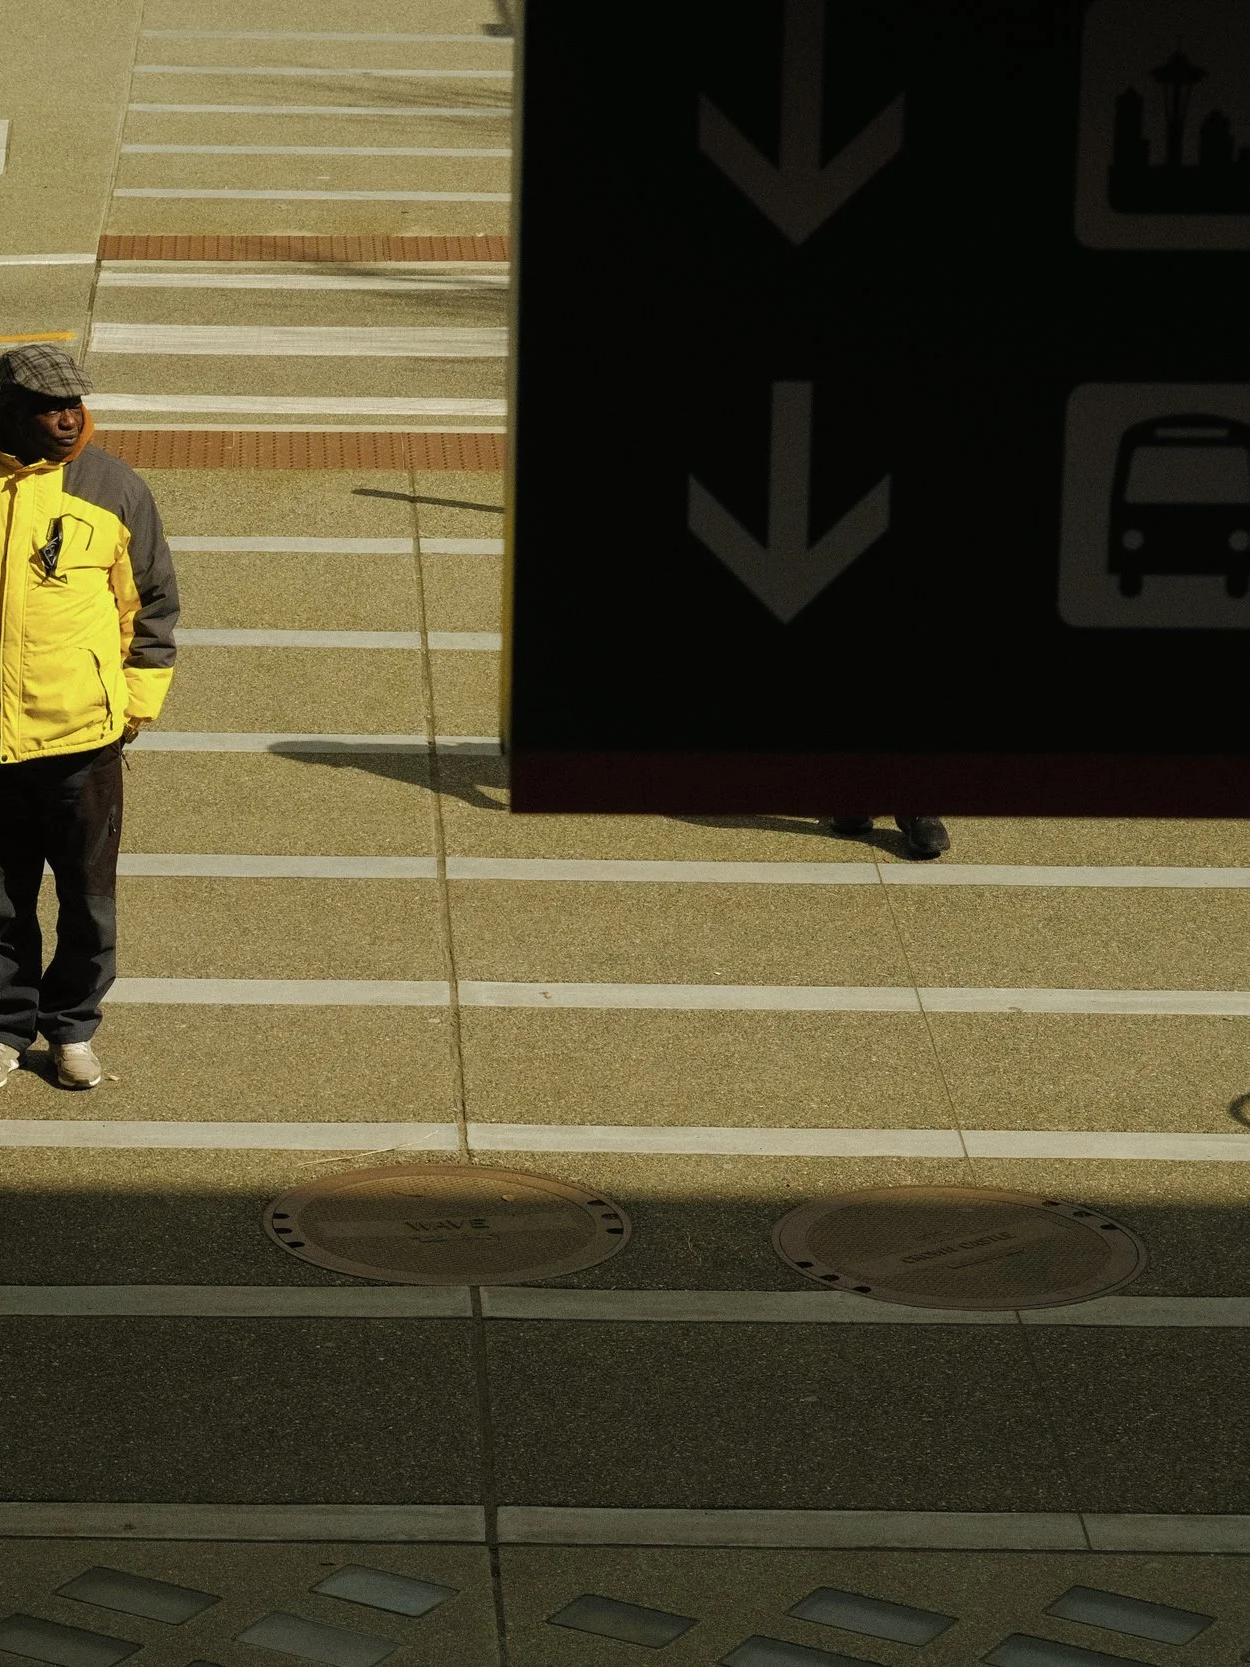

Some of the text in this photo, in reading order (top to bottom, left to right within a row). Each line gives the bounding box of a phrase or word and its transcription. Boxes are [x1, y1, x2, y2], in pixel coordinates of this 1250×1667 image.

[405, 1217, 490, 1231] WAVE
[902, 1232, 1016, 1263] CROWN CASTLE
